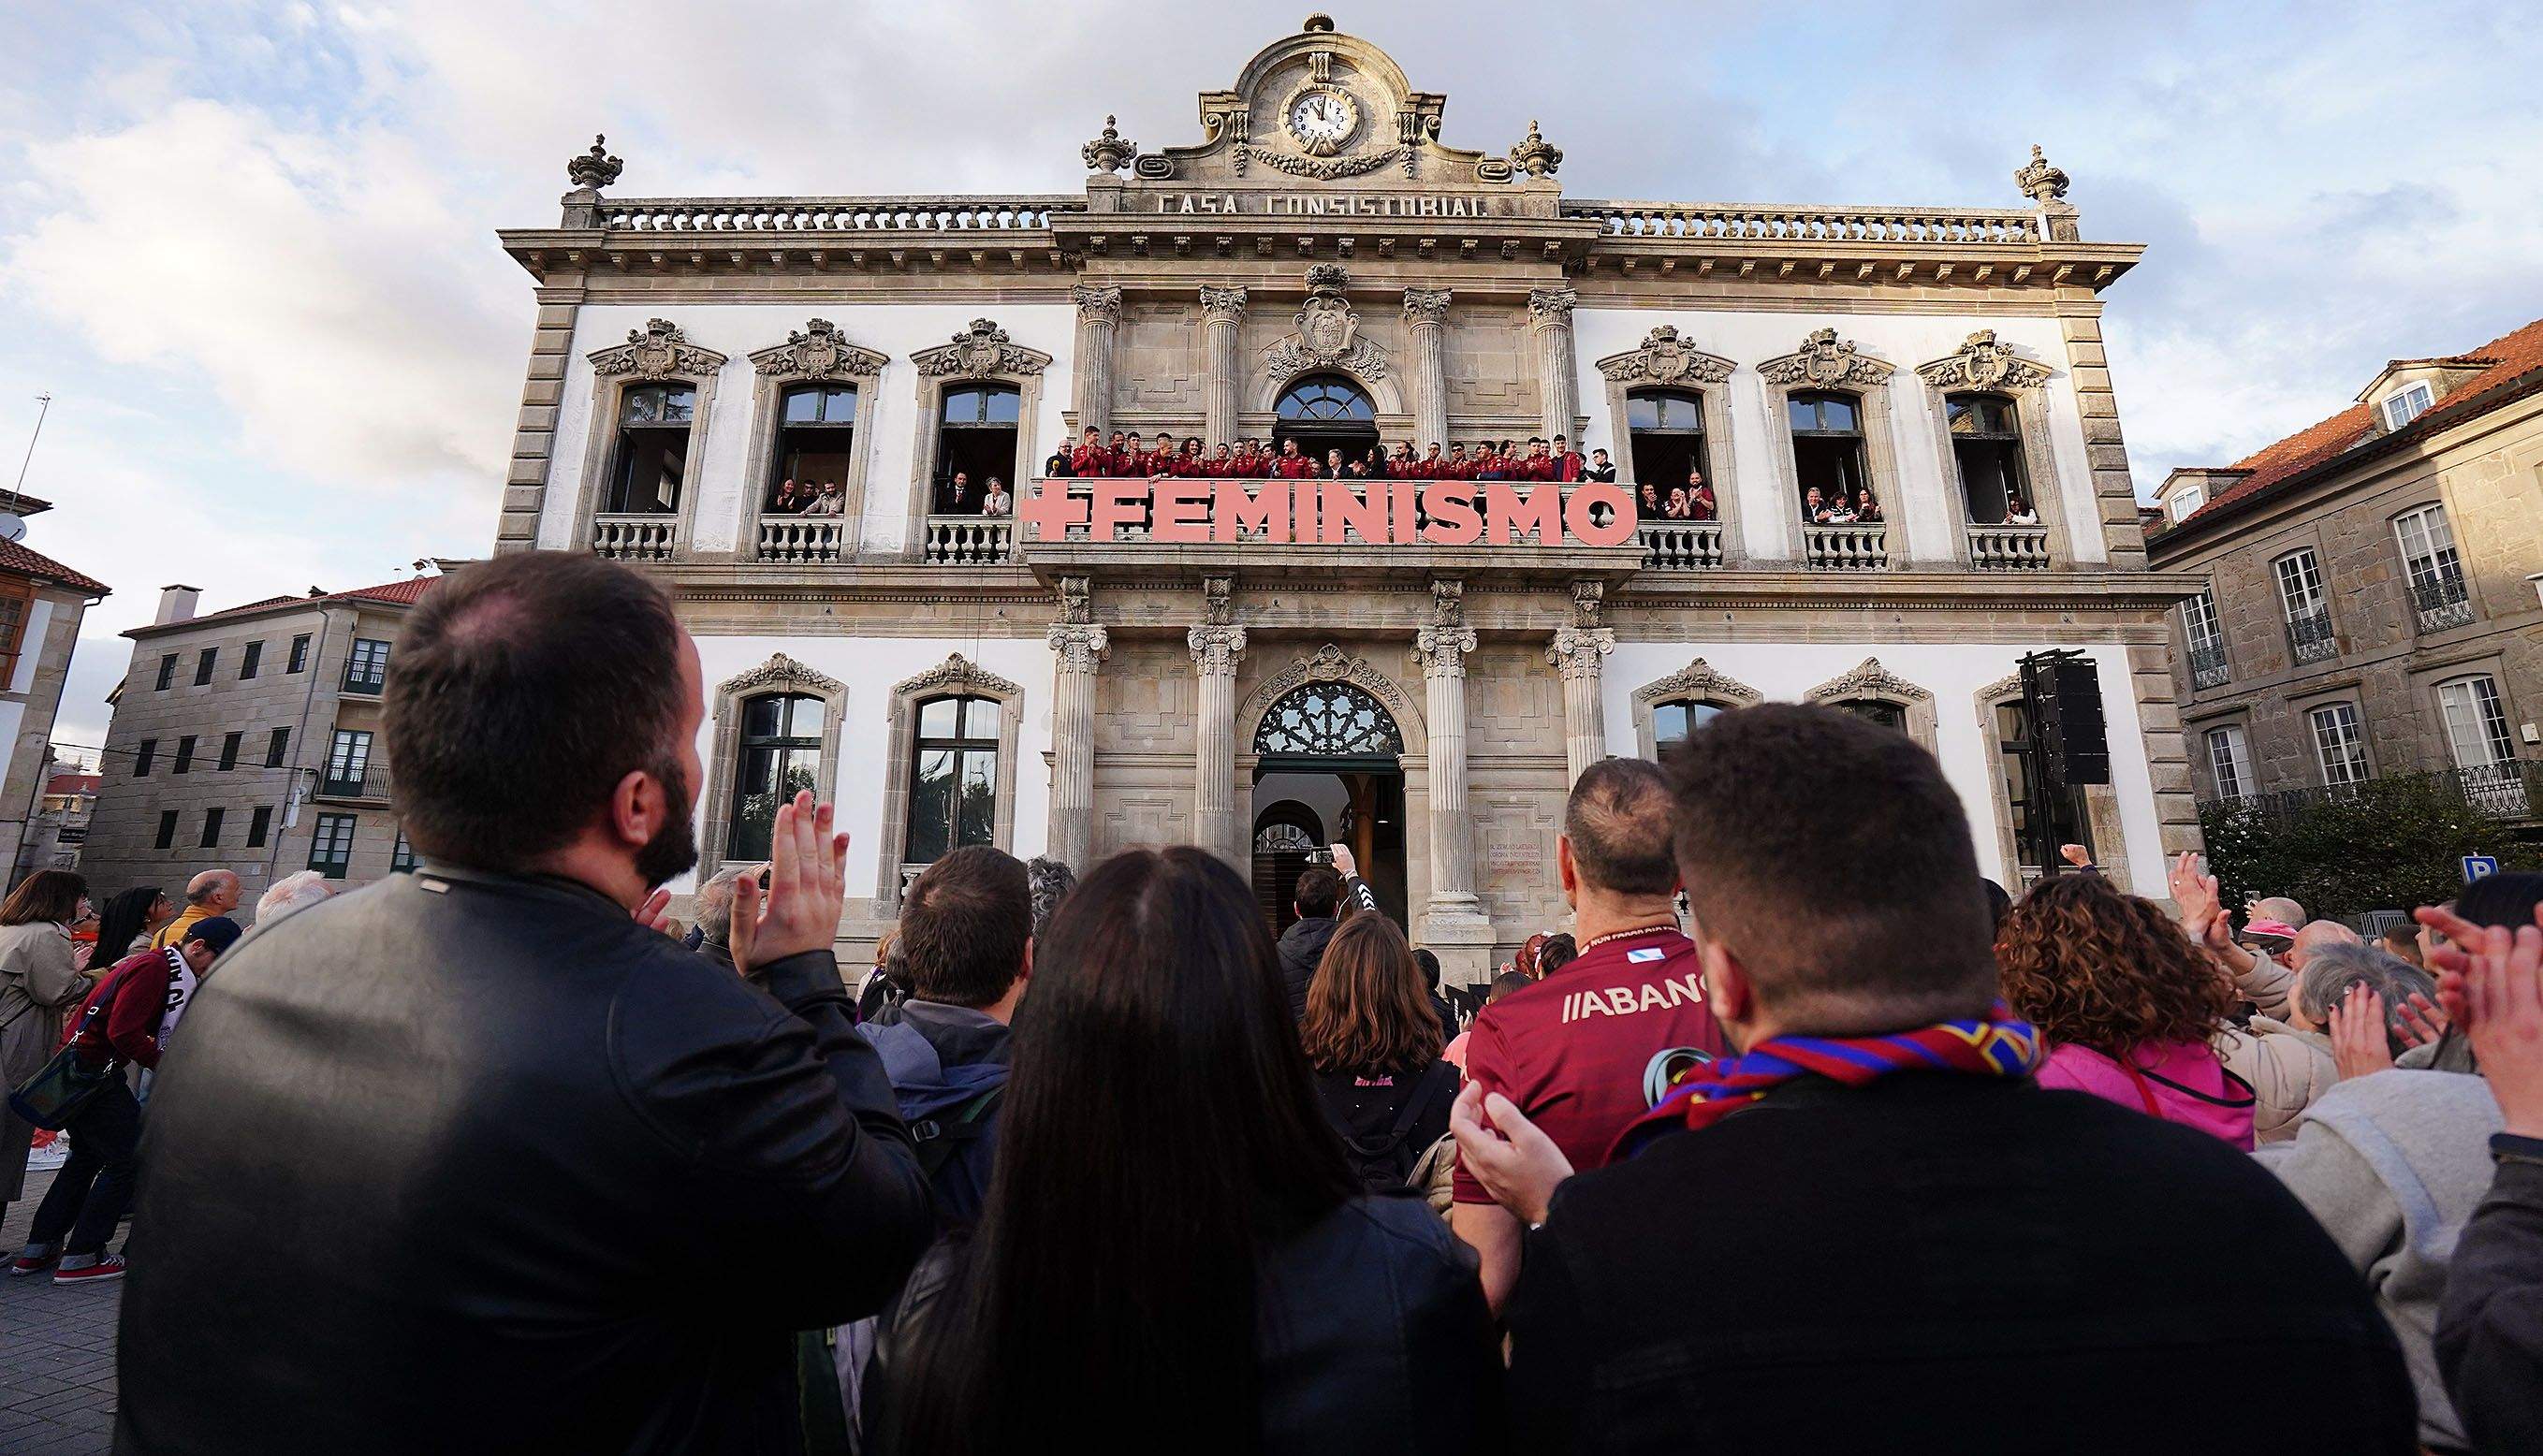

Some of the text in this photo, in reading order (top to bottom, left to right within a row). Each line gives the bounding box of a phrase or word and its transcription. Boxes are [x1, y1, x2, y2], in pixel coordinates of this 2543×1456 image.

[1158, 195, 1488, 217] CASA CONSISTORIAL
[2471, 861, 2491, 882] P
[1591, 935, 1611, 947] NON
[1580, 973, 1707, 1021] ABAN
